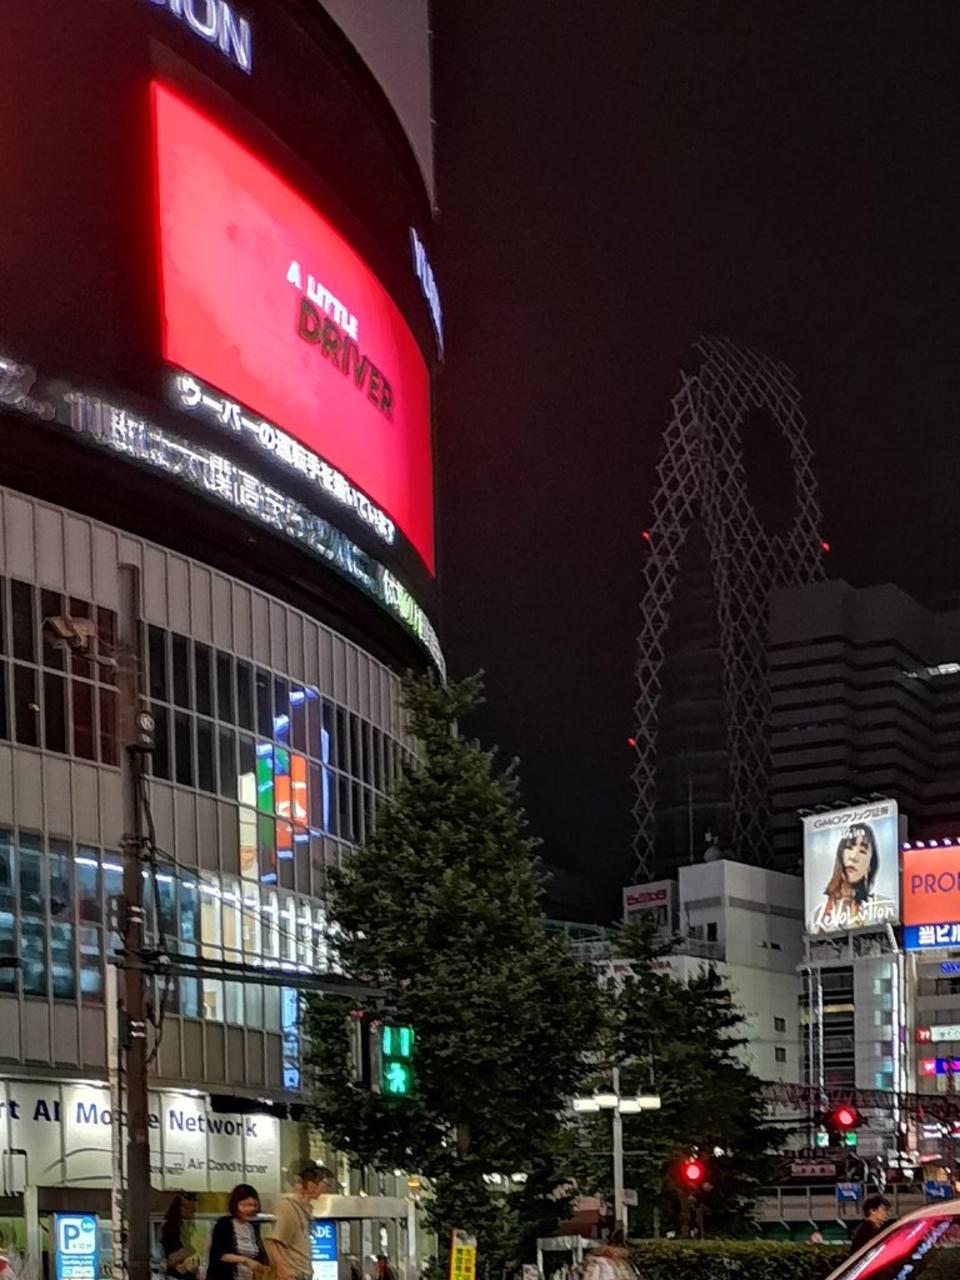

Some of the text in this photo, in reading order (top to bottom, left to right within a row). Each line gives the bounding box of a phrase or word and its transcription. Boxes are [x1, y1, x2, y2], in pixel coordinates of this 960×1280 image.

[286, 260, 360, 341] A LITTLE
[298, 297, 394, 423] DRIVER
[33, 1099, 61, 1123] AI
[76, 1102, 160, 1129] Moe
[169, 1109, 258, 1138] Network
[64, 1224, 81, 1250] P
